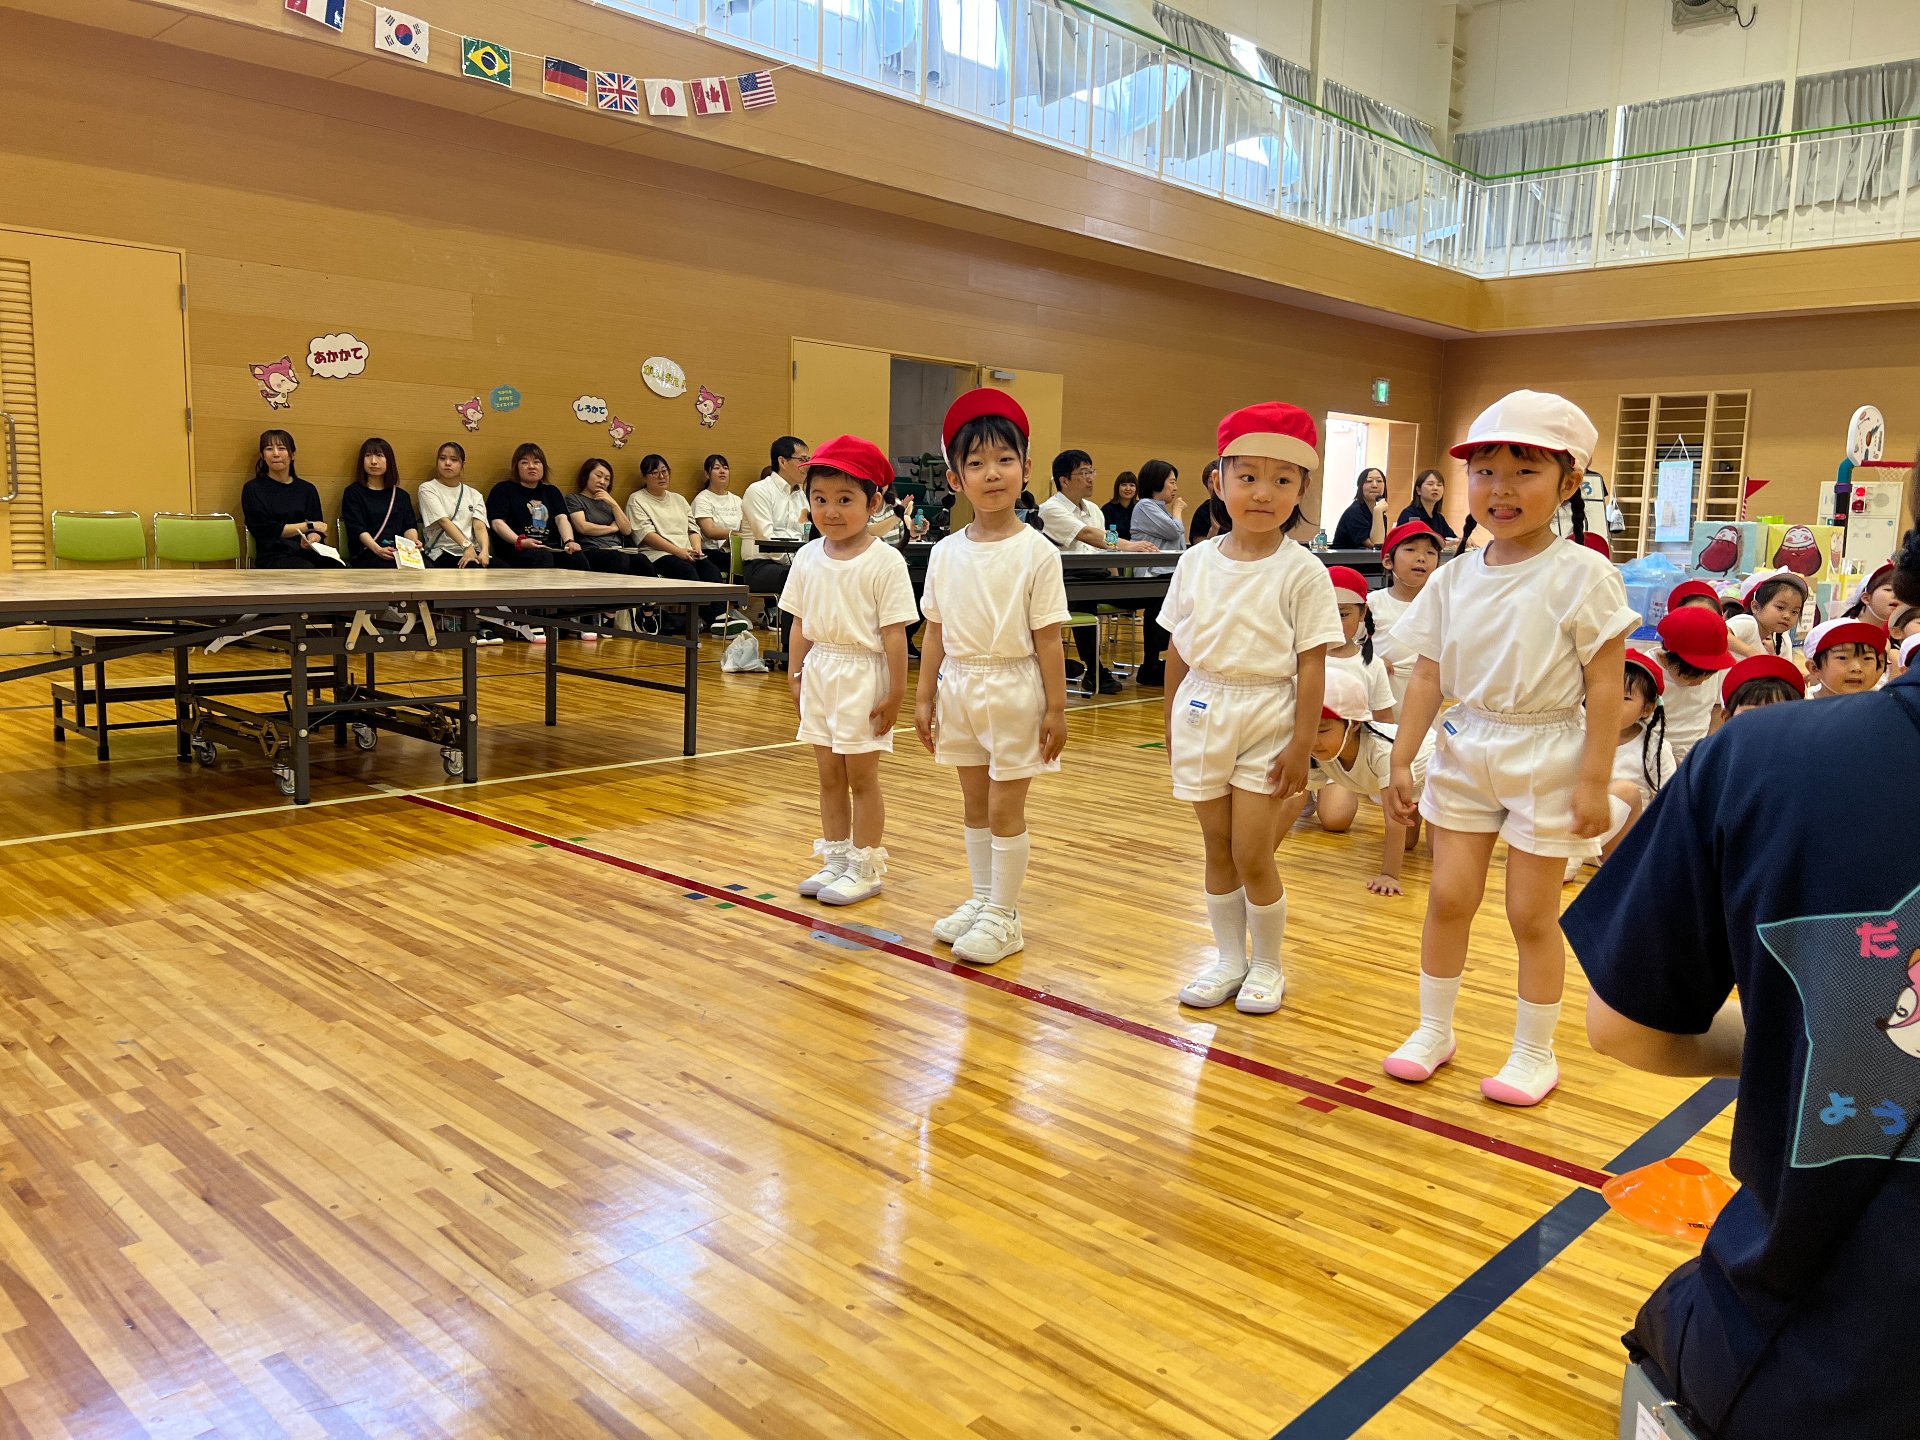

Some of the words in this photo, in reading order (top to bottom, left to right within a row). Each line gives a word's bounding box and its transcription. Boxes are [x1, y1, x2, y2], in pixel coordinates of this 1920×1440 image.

[314, 347, 363, 364] あかかて
[577, 404, 605, 415] しろかて
[1855, 919, 1900, 958] だ
